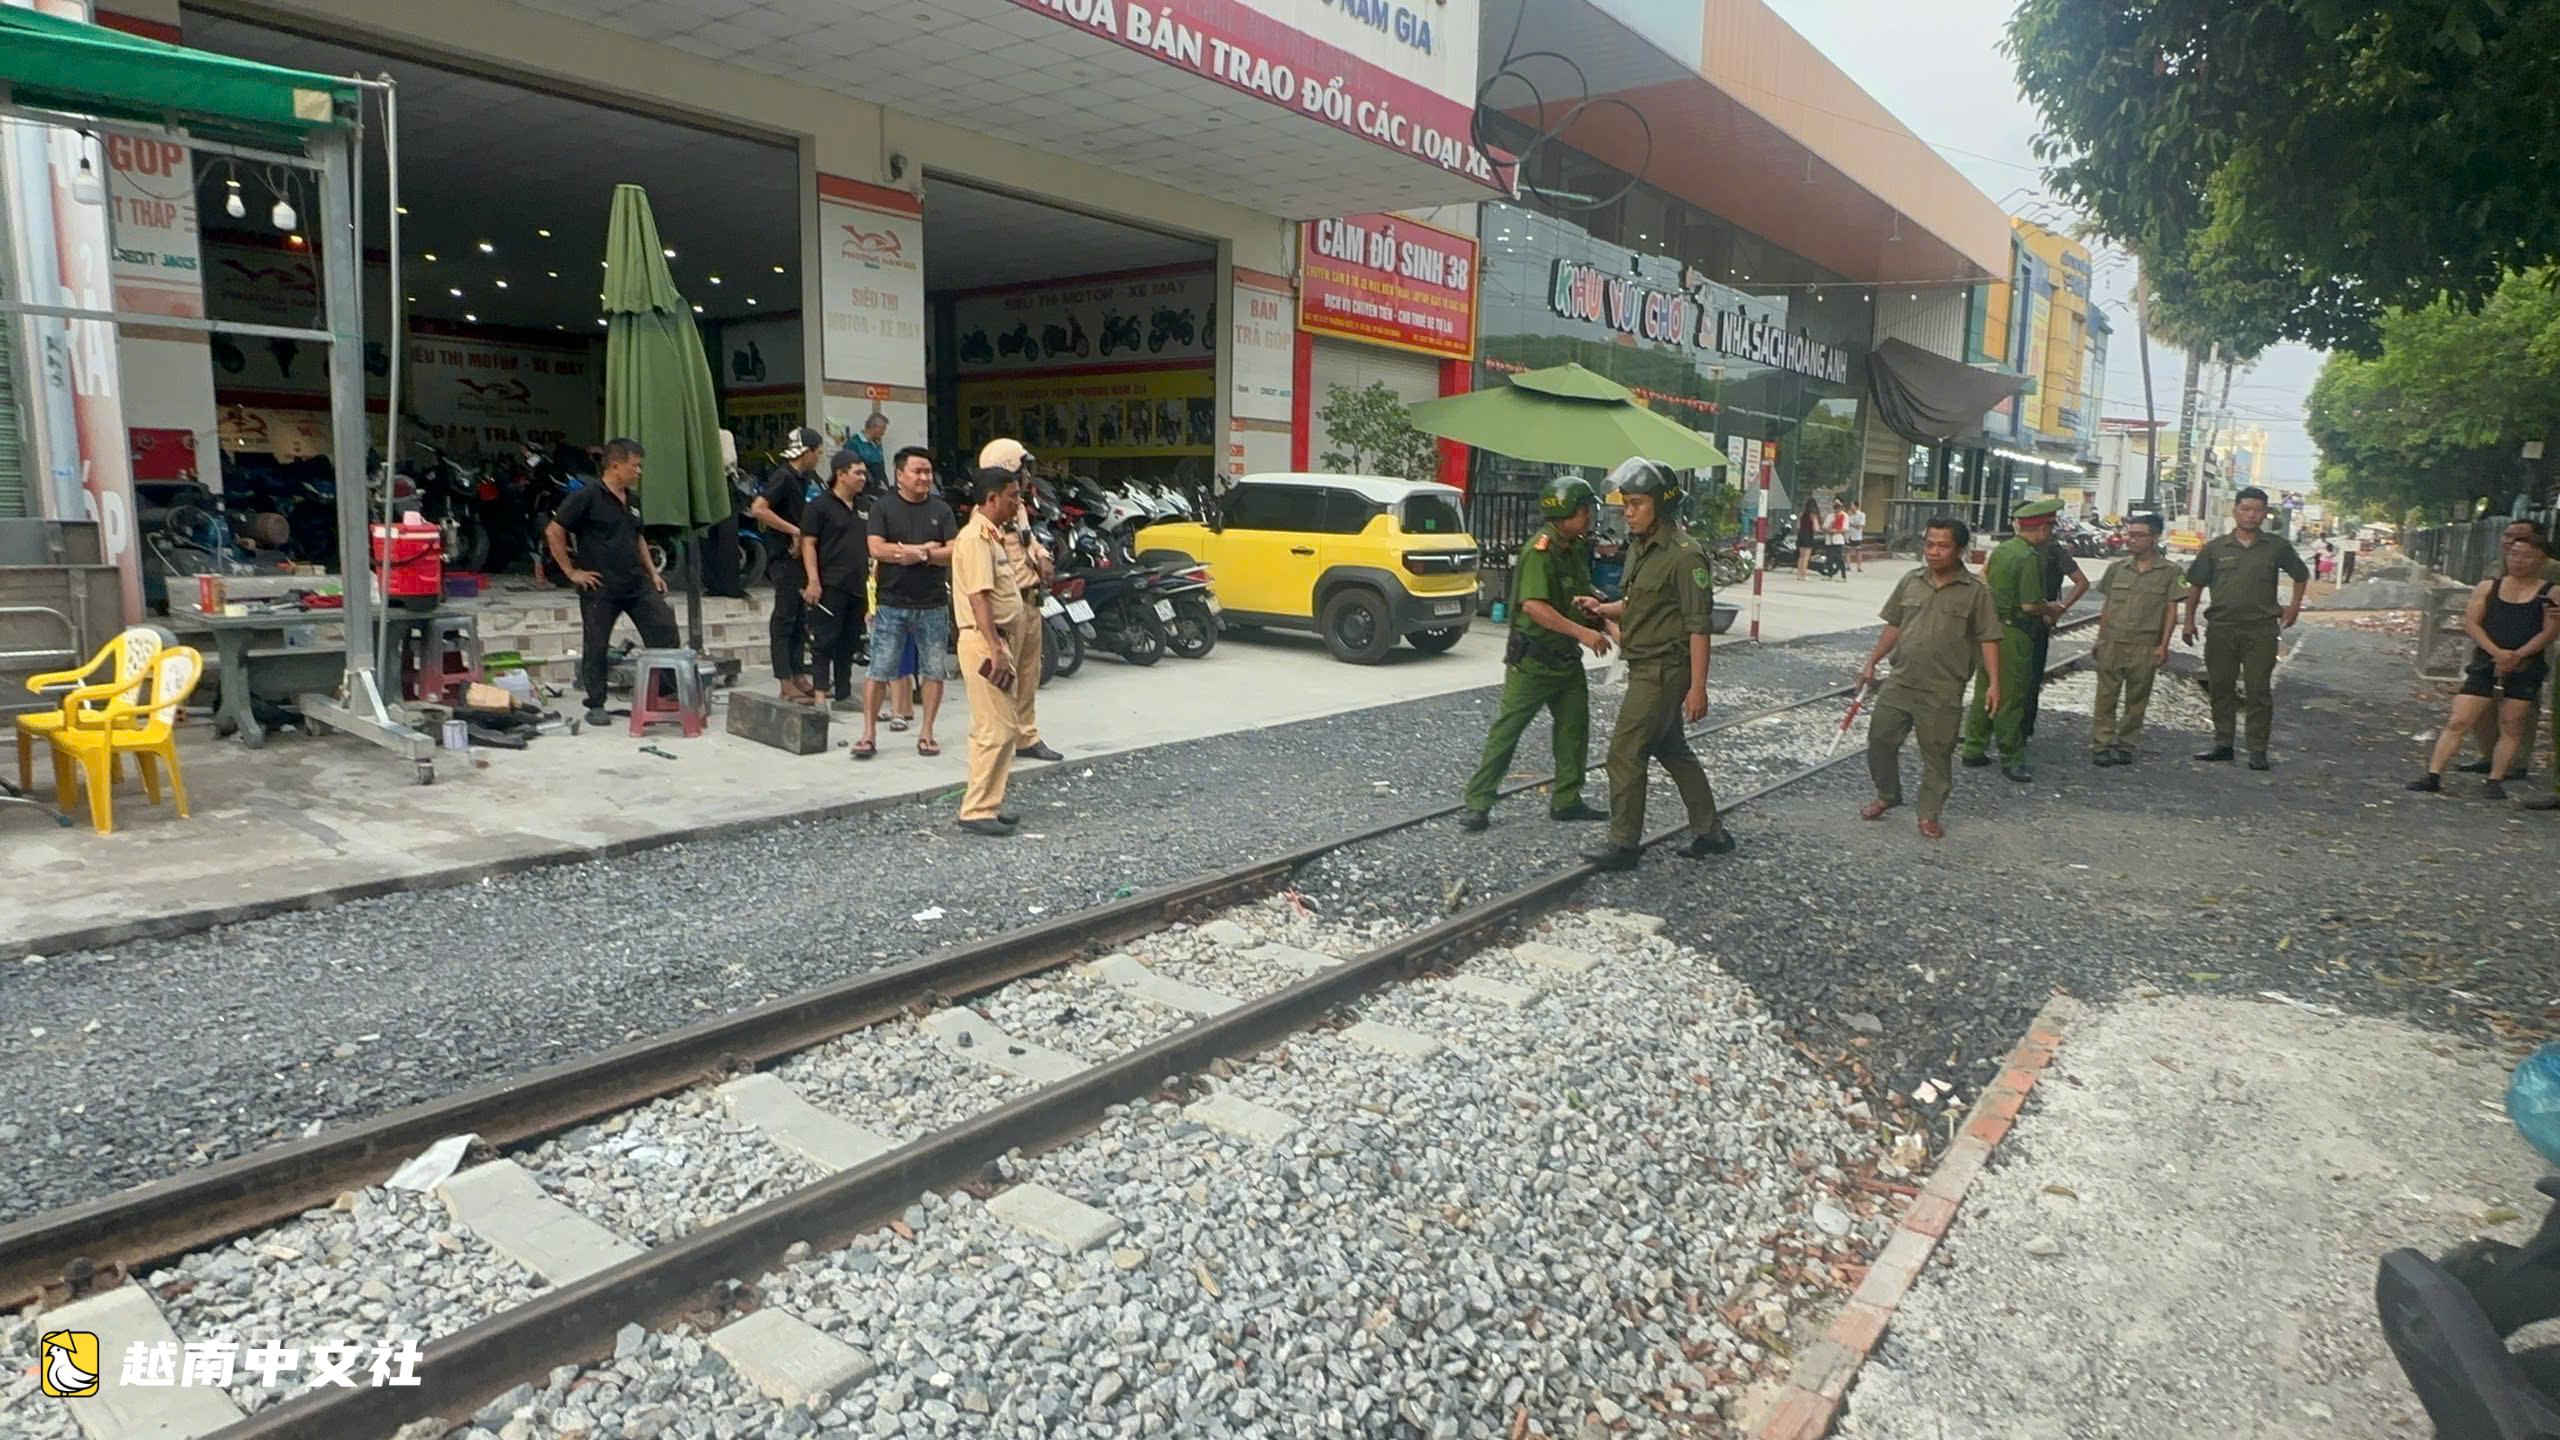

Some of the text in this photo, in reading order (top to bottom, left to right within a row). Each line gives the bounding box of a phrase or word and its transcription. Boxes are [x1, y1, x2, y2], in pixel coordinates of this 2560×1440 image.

[1395, 7, 1432, 55] GIA
[1126, 3, 1202, 68] BÁN
[1210, 37, 1295, 101] TRAO
[1302, 76, 1352, 127] ĐỔI
[1357, 101, 1407, 147] CÁC
[1411, 124, 1463, 169] LOẠI
[1465, 145, 1492, 181] XE
[1401, 240, 1444, 285] SINH
[1447, 254, 1469, 292] 38
[1554, 259, 1603, 321] KHU
[1608, 278, 1642, 333] VUI
[1825, 346, 1848, 385] ANH
